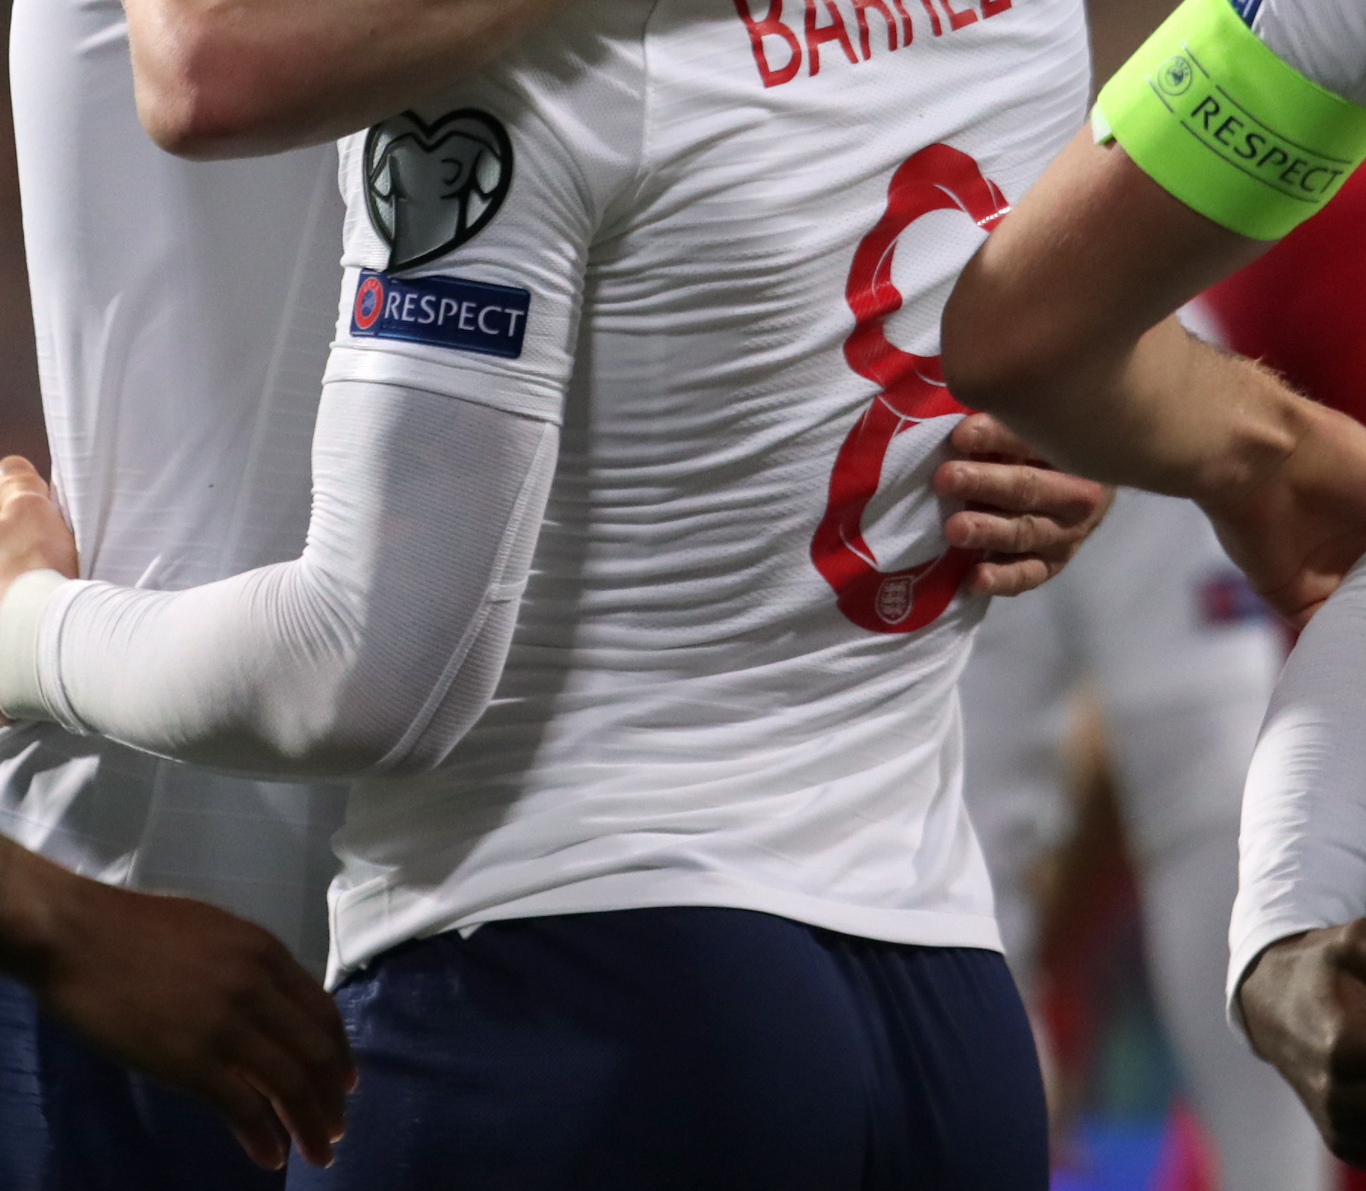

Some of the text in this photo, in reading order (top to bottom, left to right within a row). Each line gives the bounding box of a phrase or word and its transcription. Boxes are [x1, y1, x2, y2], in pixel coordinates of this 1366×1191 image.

[1189, 95, 1345, 195] RESPECT
[384, 290, 525, 338] RESPECT
[809, 142, 1014, 634] 8
